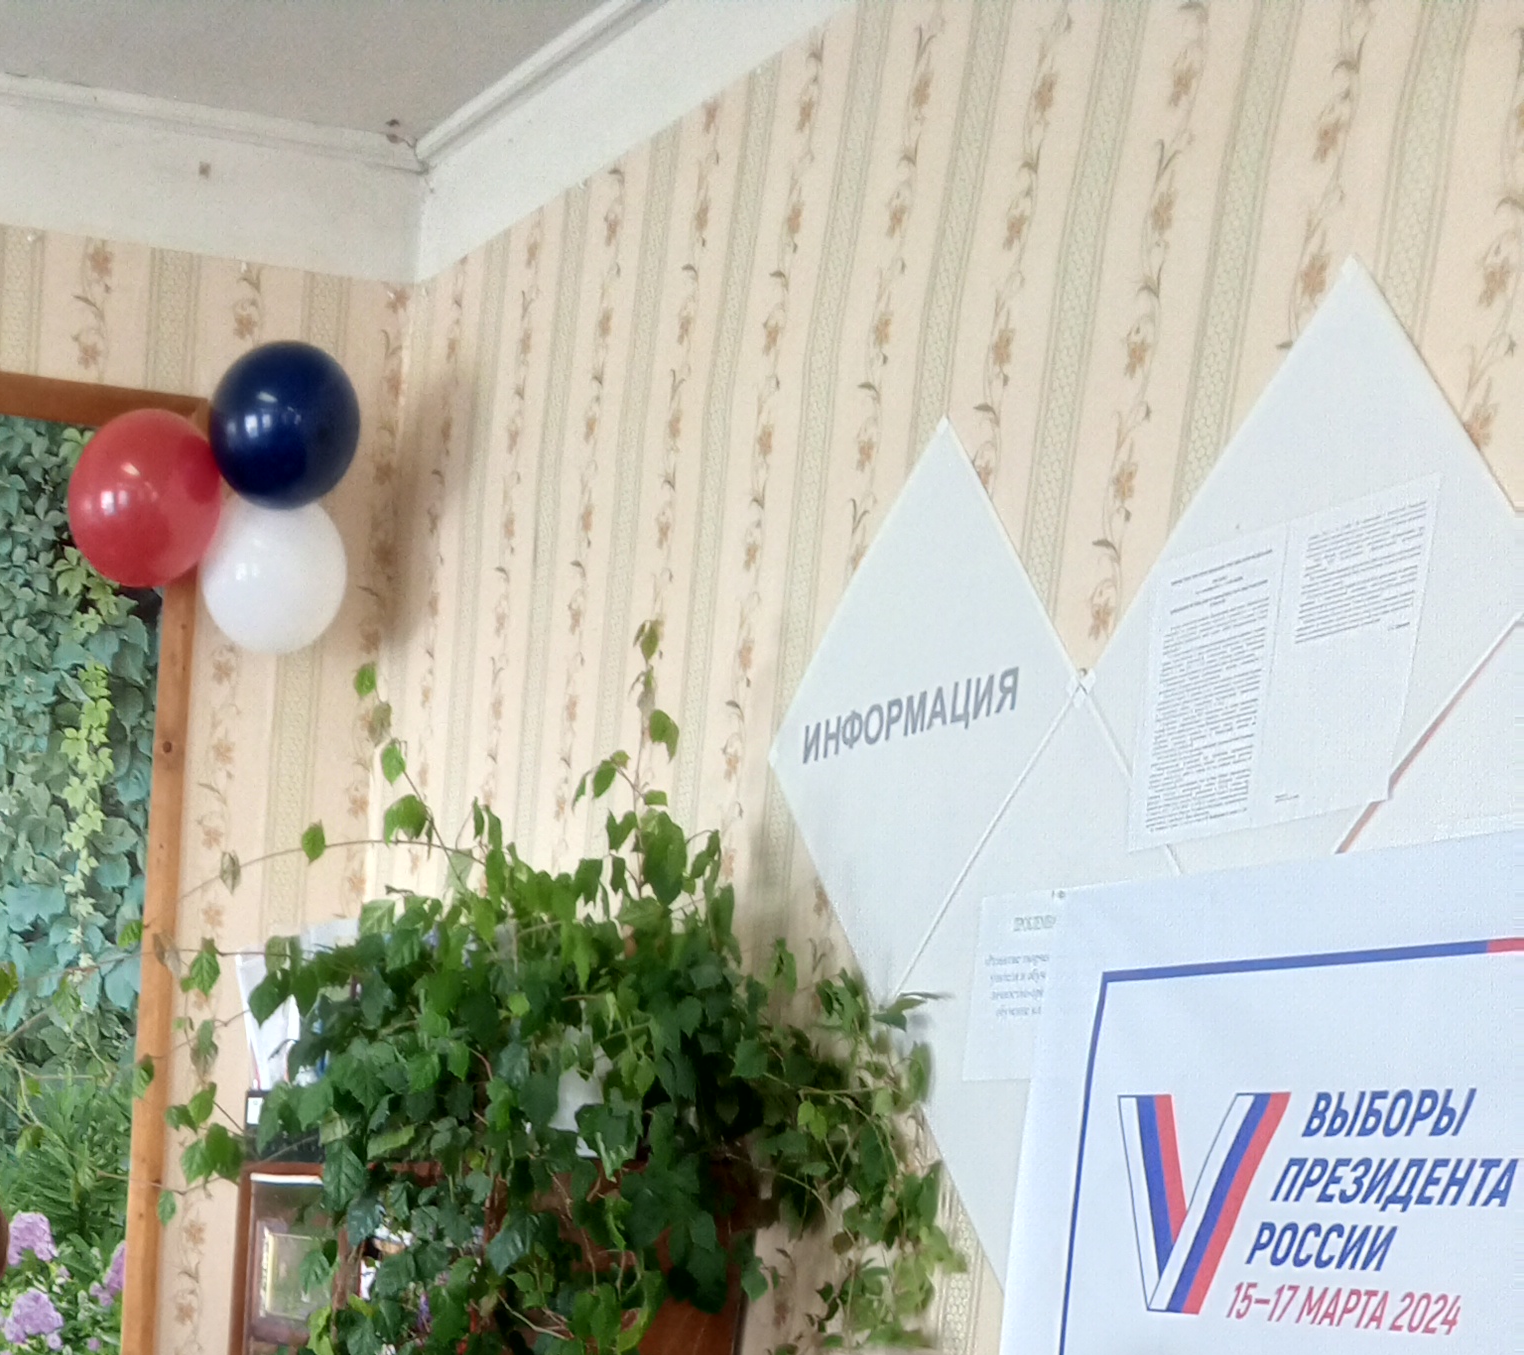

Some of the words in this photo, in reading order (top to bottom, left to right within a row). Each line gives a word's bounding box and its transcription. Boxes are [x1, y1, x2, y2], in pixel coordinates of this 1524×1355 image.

[803, 666, 1020, 764] ИНФОРМАЦИЯ
[1301, 1087, 1477, 1138] ВЫБОРЫ
[1270, 1157, 1519, 1213] ПРЕЗИДЕНТА
[1245, 1221, 1398, 1271] РОССИИ
[1295, 1286, 1390, 1330] МАРТА
[1388, 1292, 1461, 1336] 2024
